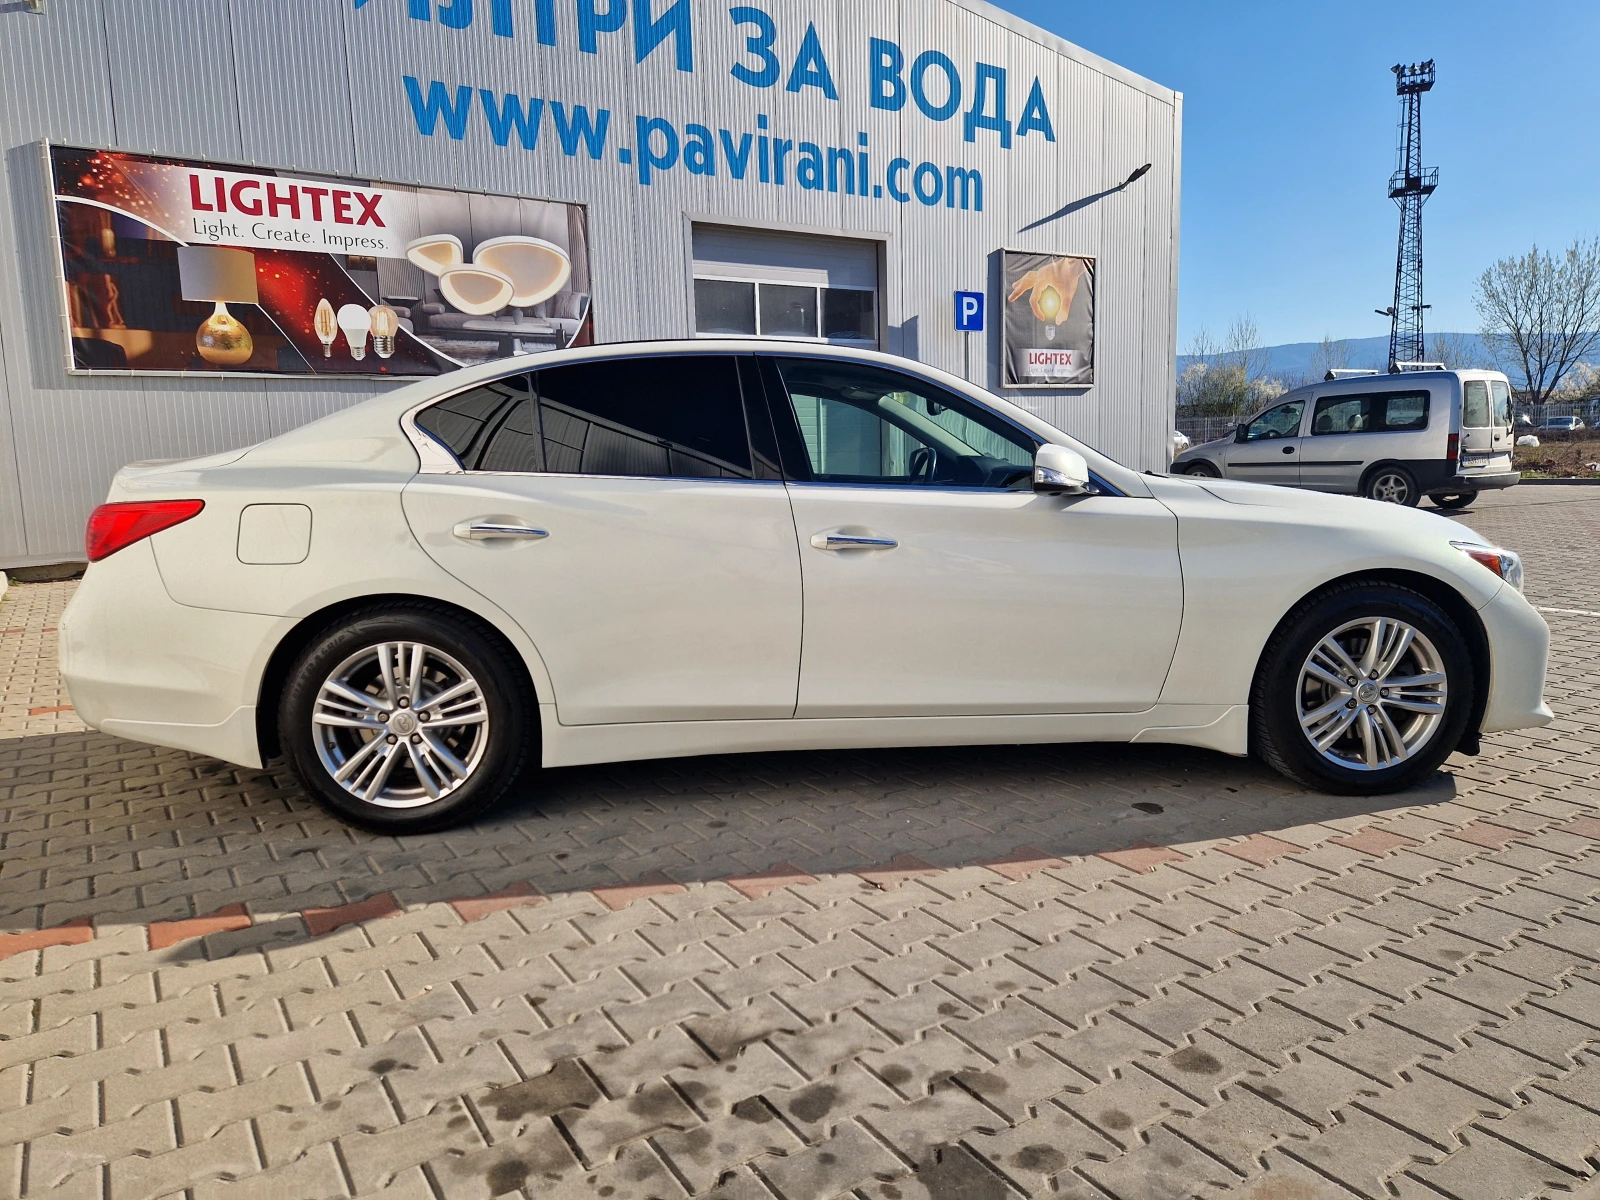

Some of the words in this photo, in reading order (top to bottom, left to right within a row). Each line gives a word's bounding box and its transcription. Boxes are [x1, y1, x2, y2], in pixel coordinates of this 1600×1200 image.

[730, 7, 839, 101] ЗА
[870, 38, 1055, 149] ВОДА
[402, 75, 983, 212] www.pavirani.com
[189, 174, 386, 228] LIGHTEX
[193, 217, 244, 241] Light.
[252, 222, 315, 244] Create.
[322, 228, 389, 250] Impress.
[962, 296, 978, 326] P
[1029, 352, 1072, 366] LIGHTEX
